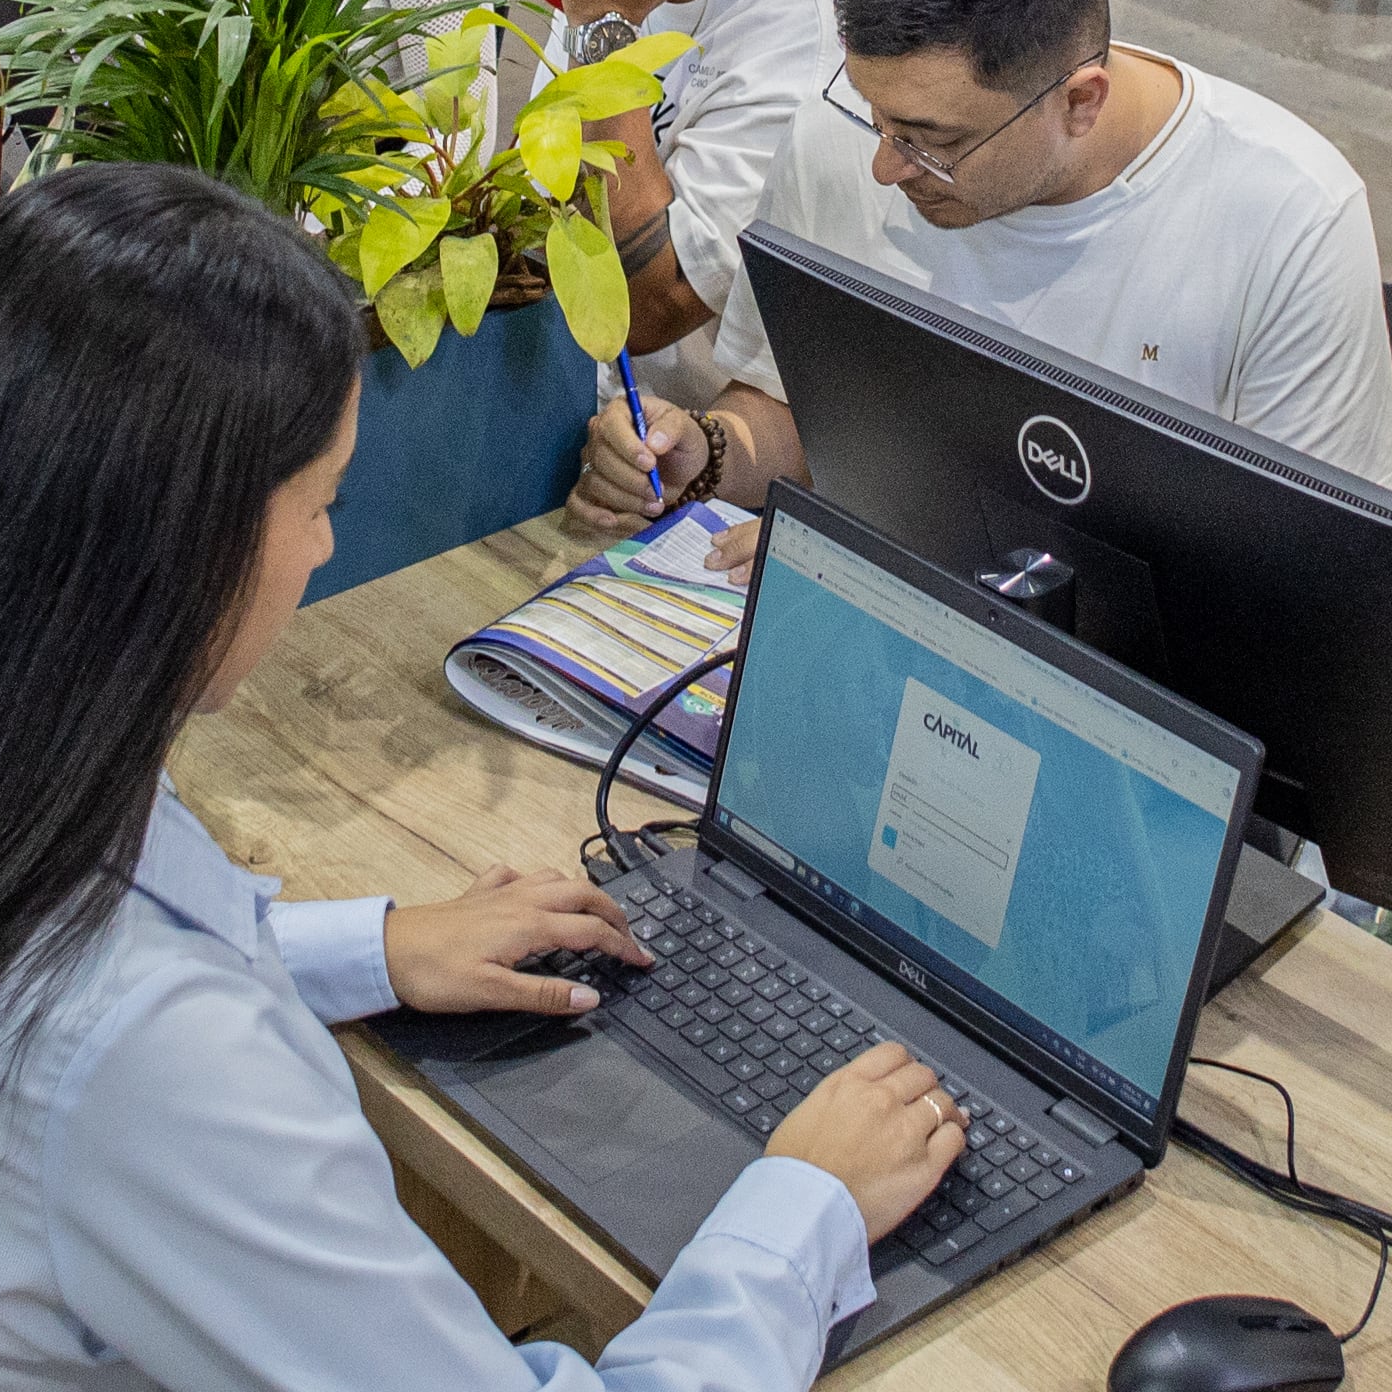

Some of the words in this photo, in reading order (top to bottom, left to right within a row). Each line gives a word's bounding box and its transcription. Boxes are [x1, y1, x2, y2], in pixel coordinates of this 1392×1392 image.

[1140, 343, 1160, 362] M
[1027, 439, 1084, 485] DELL
[923, 712, 981, 760] CAPITAL
[899, 959, 927, 989] DELL
